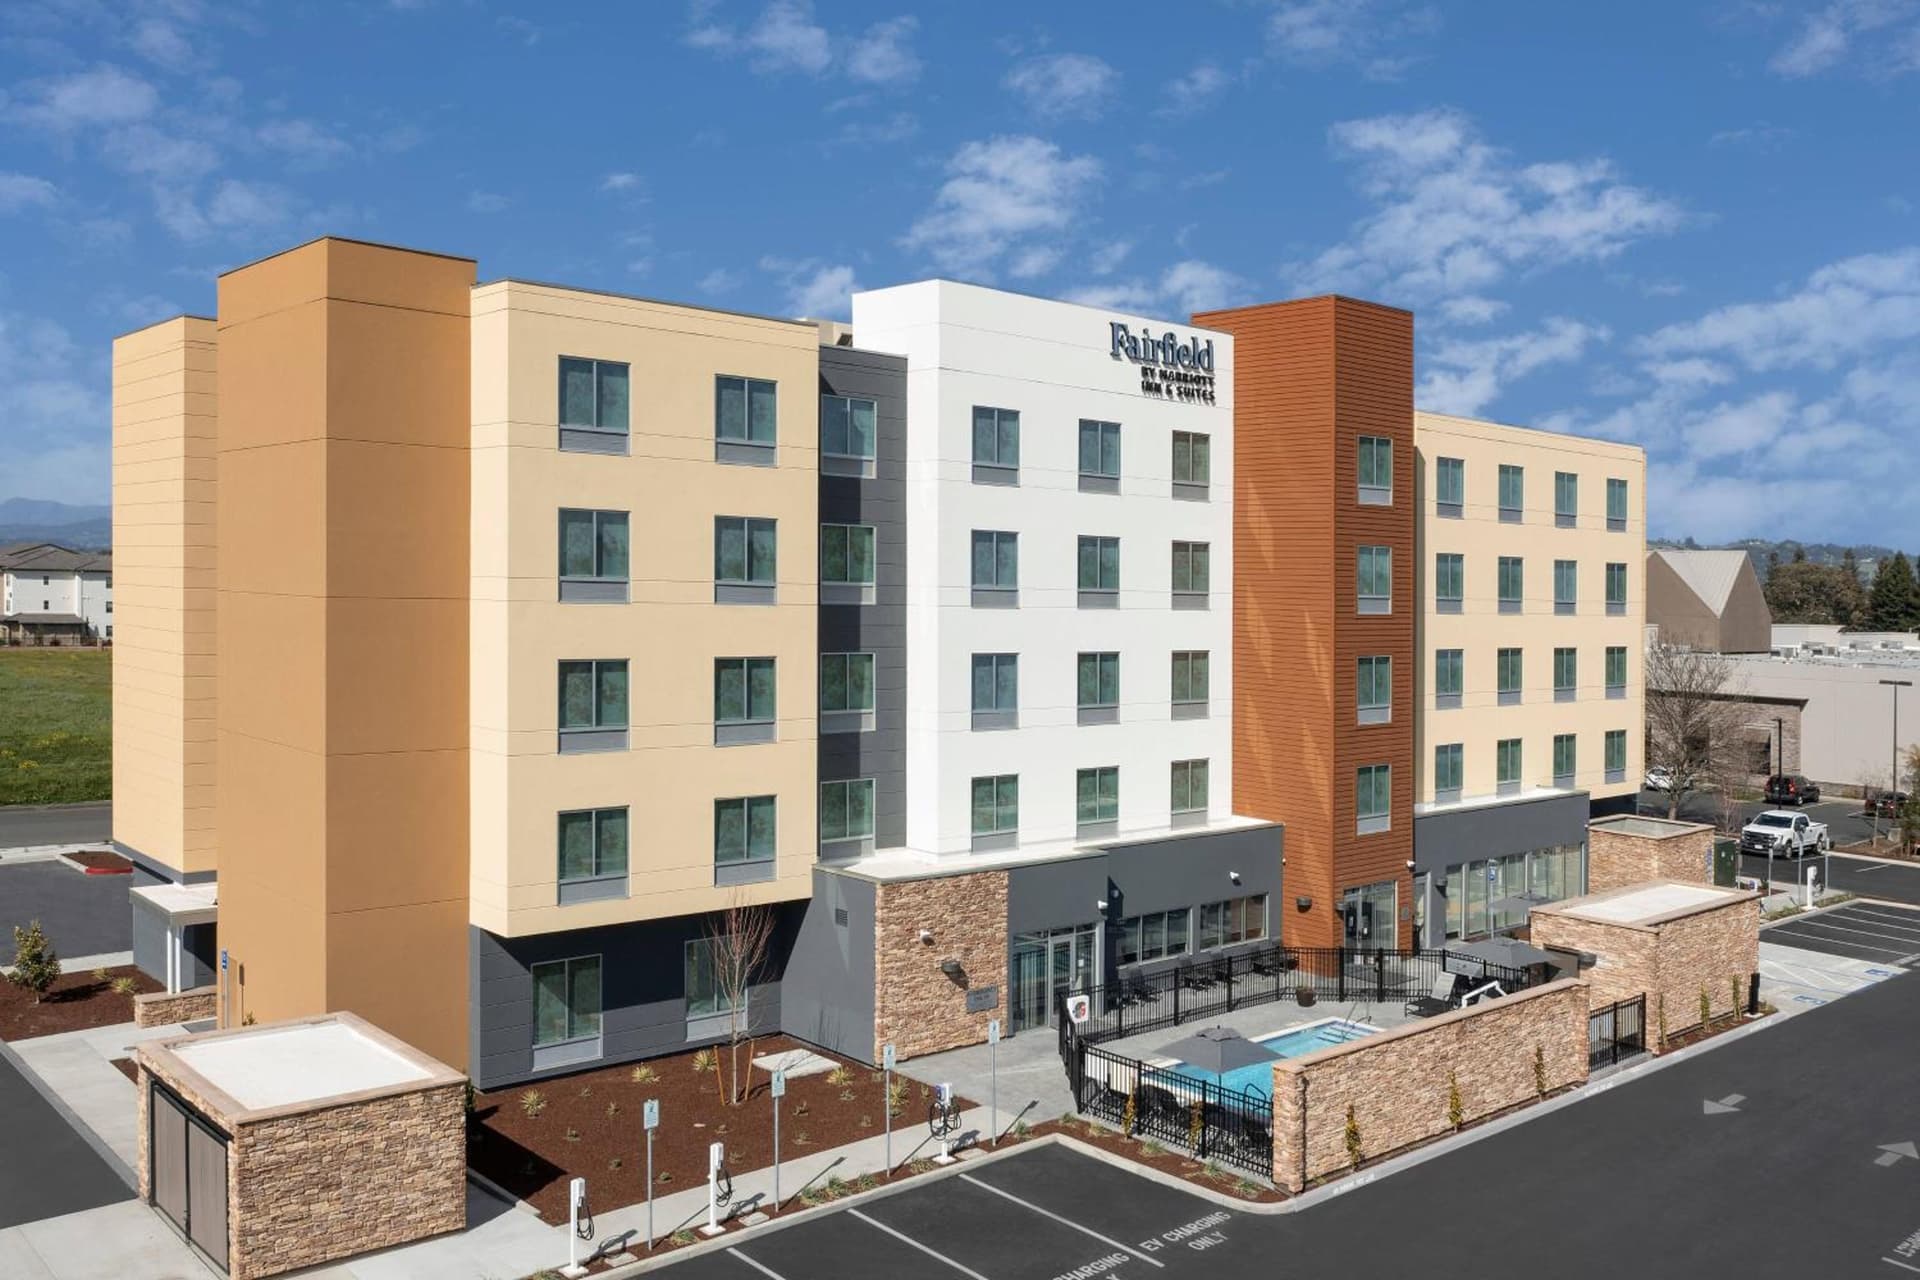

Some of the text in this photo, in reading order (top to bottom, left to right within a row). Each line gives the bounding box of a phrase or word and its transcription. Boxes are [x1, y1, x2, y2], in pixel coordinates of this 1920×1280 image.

[1109, 321, 1215, 373] Fairfield
[1141, 366, 1215, 386] BY MARRIOTT
[1141, 381, 1161, 394] INN
[1176, 386, 1215, 401] SUITES
[1138, 1211, 1232, 1252] EV CHARGING
[1187, 1231, 1229, 1251] ONLY
